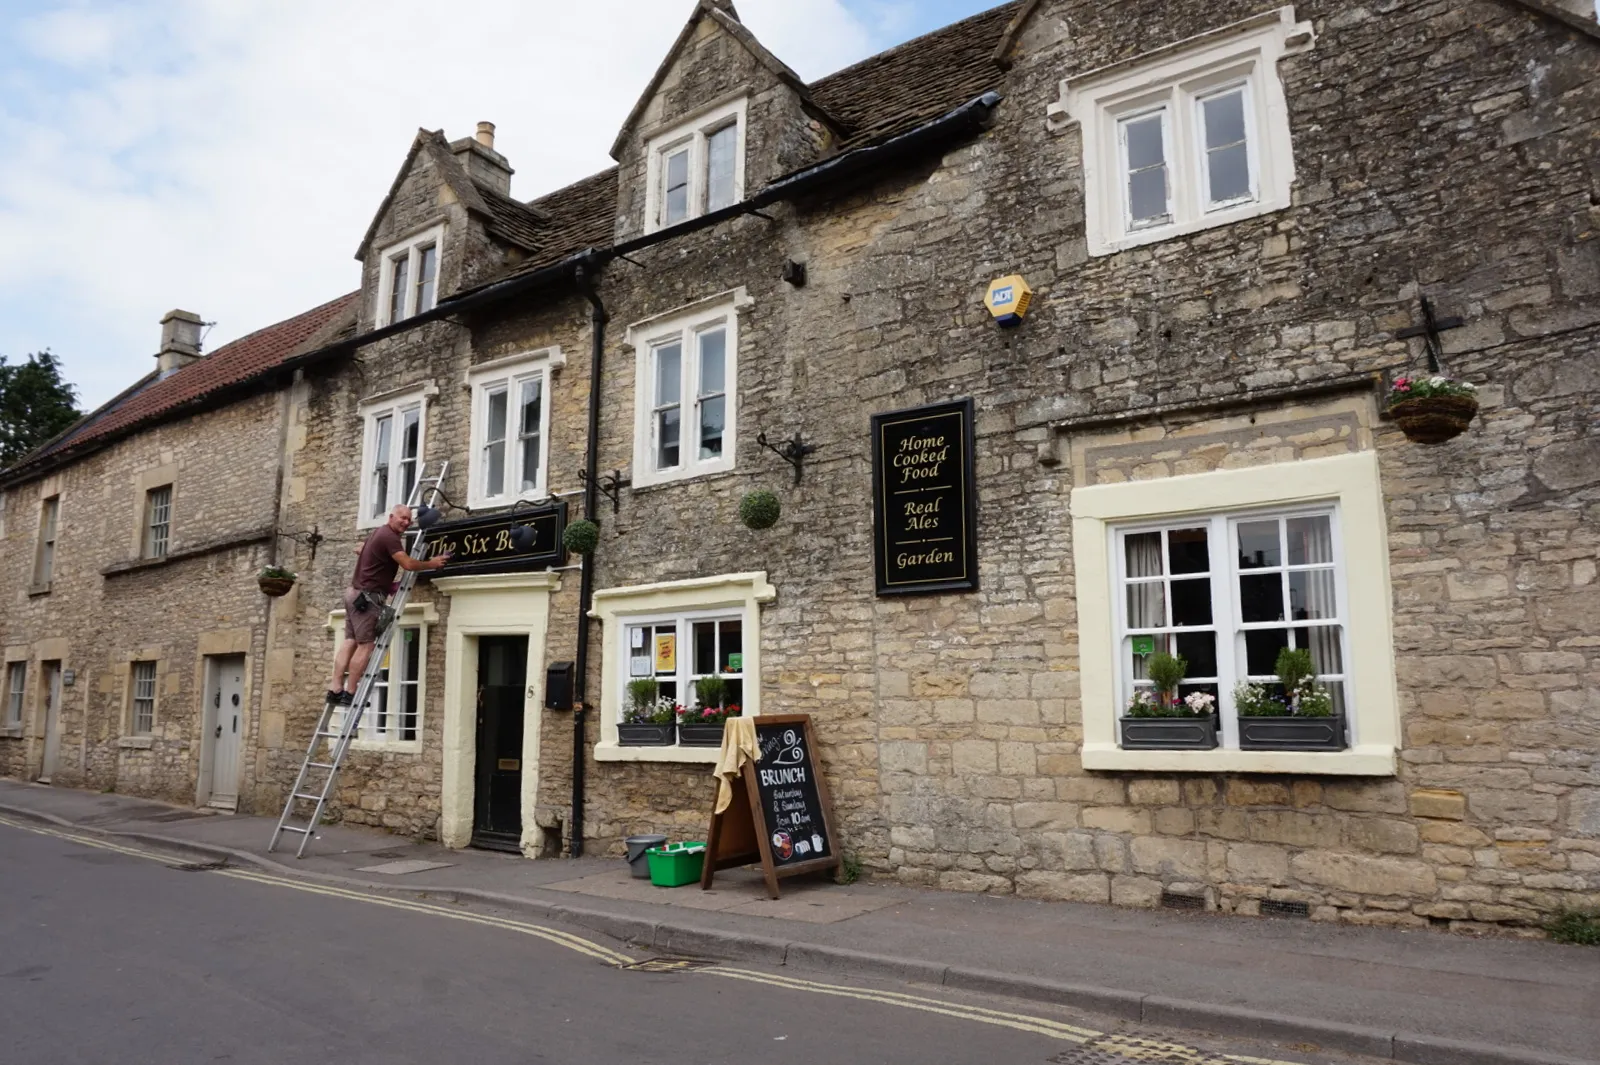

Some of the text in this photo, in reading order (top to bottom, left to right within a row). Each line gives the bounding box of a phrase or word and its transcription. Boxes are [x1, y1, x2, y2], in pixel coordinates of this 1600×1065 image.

[992, 289, 1012, 303] ADT
[899, 436, 945, 452] Home
[893, 445, 950, 467] Cooked
[900, 461, 942, 483] Food
[904, 497, 943, 516] Real
[905, 514, 939, 531] Ales
[428, 535, 456, 560] The
[461, 533, 490, 556] Six
[897, 548, 954, 569] Garden
[760, 767, 806, 786] BRUNCH
[773, 788, 803, 800] Saturday
[773, 799, 807, 813] & Sunday
